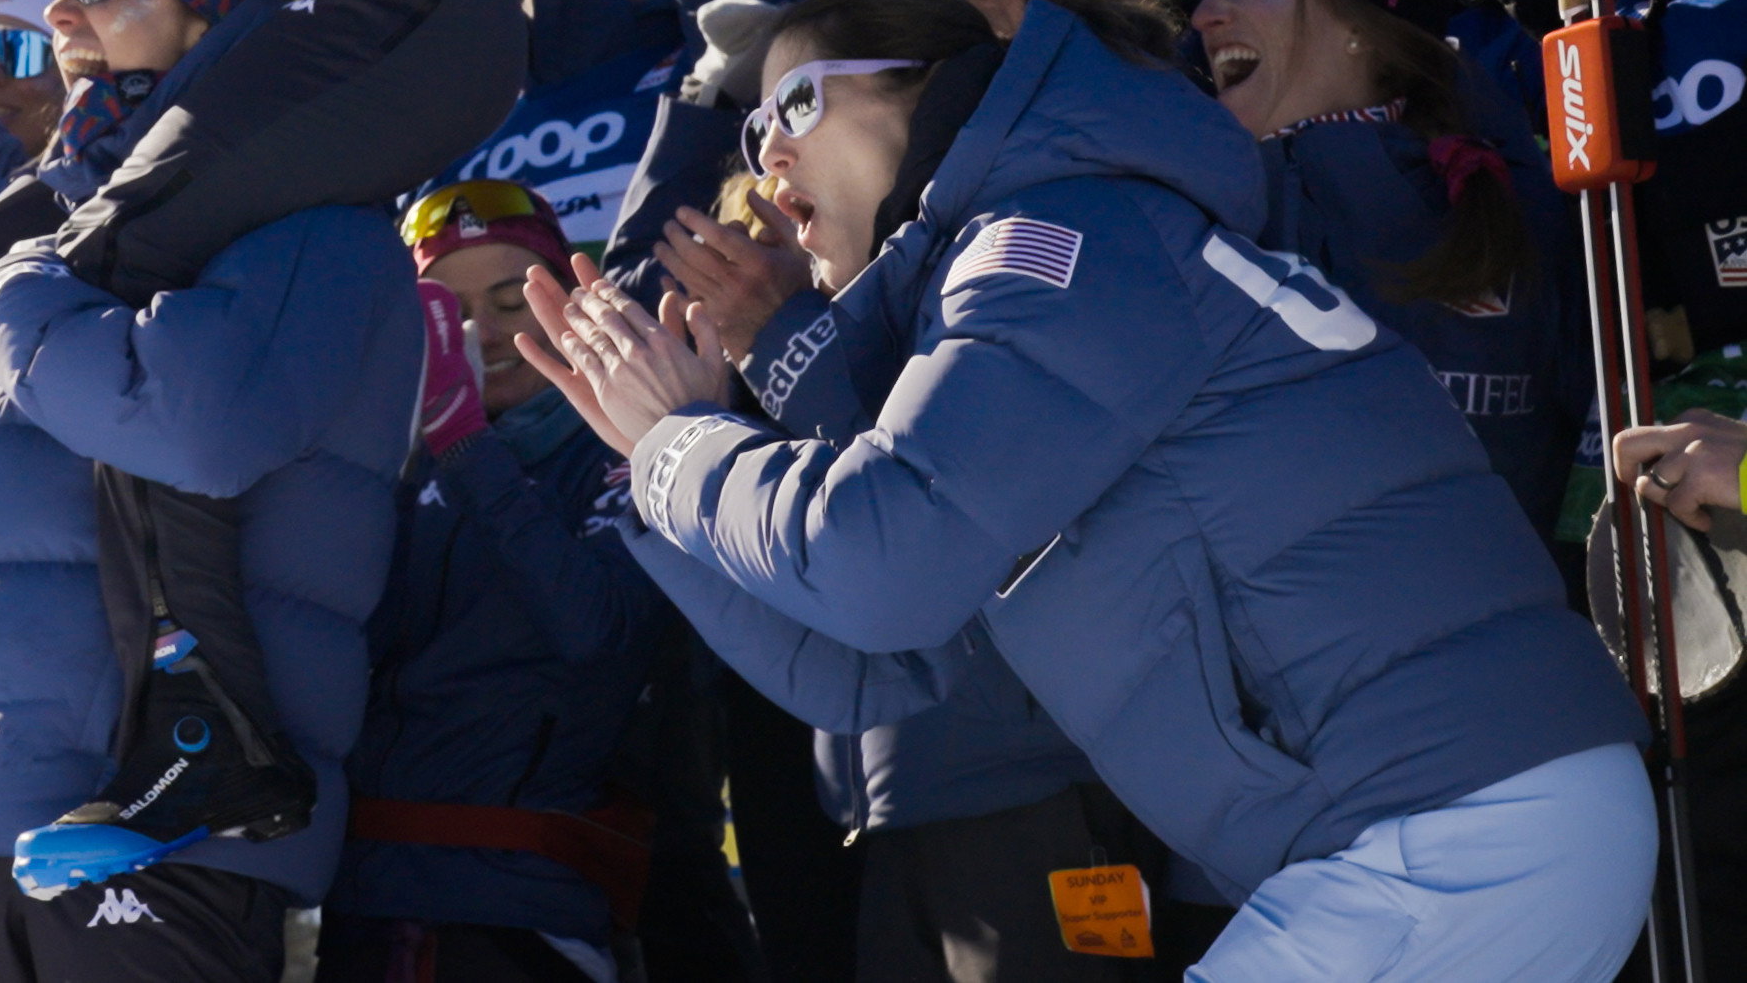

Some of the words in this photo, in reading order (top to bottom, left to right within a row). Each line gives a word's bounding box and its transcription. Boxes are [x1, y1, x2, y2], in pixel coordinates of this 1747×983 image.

[1437, 371, 1535, 416] TIFEL
[119, 758, 189, 820] SALOMON
[1067, 872, 1125, 888] SUNDAY
